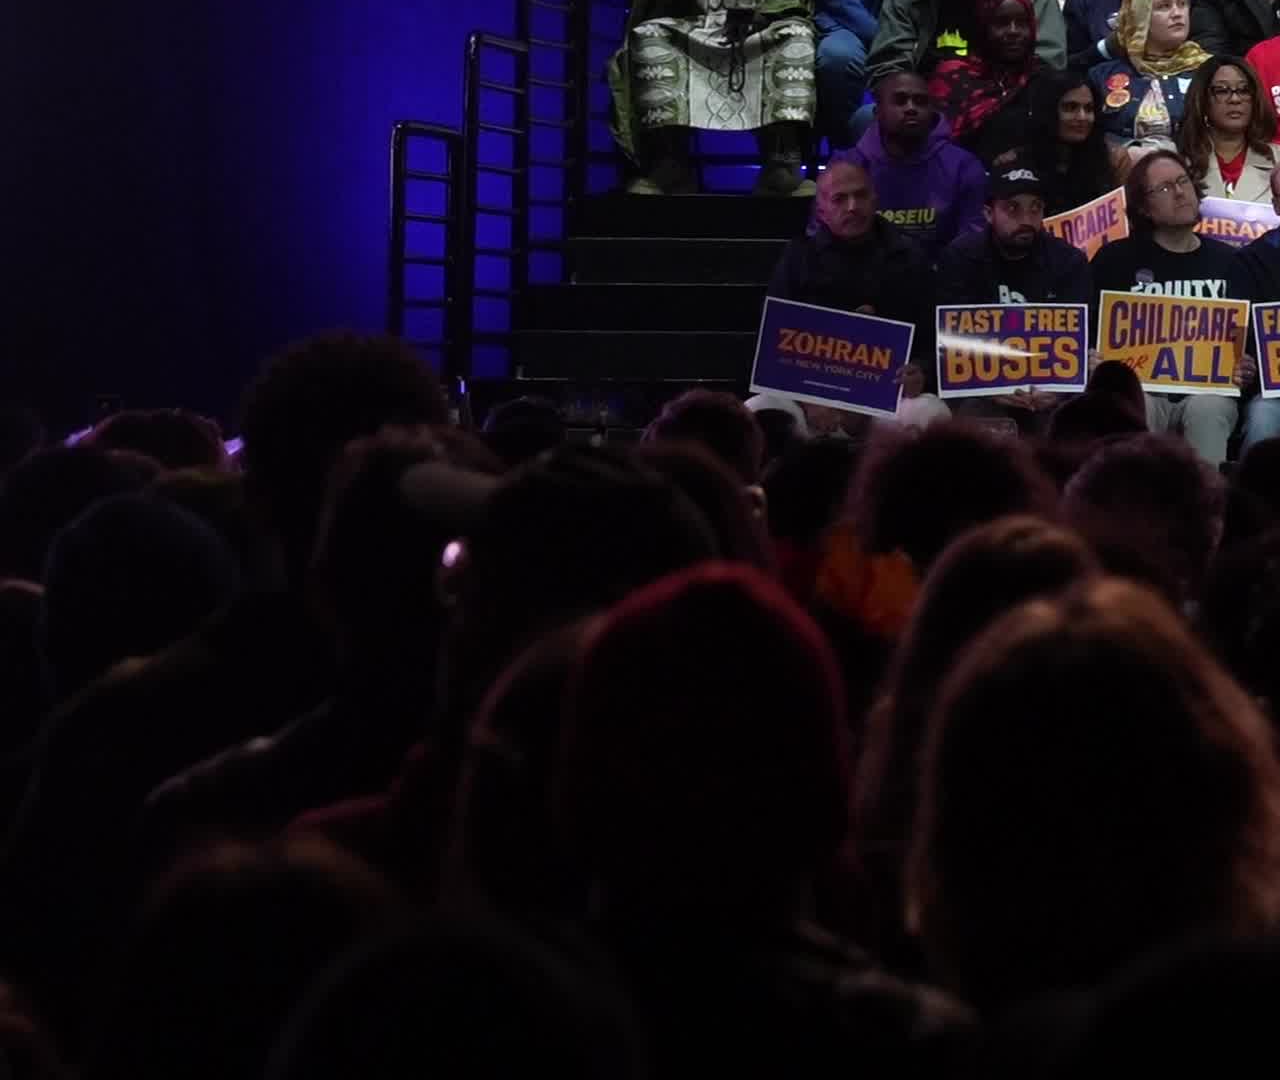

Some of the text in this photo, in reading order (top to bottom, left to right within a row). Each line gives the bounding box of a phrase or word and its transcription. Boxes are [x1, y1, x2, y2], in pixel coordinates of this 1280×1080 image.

[945, 310, 1005, 335] FAST
[1024, 309, 1081, 333] FREE
[1108, 301, 1239, 350] CHILDCARE
[778, 328, 893, 370] ZOHRAN
[945, 336, 1080, 384] BUSES
[1152, 345, 1230, 384] ALL
[795, 358, 821, 371] NEW
[824, 364, 852, 377] YORK
[855, 370, 883, 383] CITY
